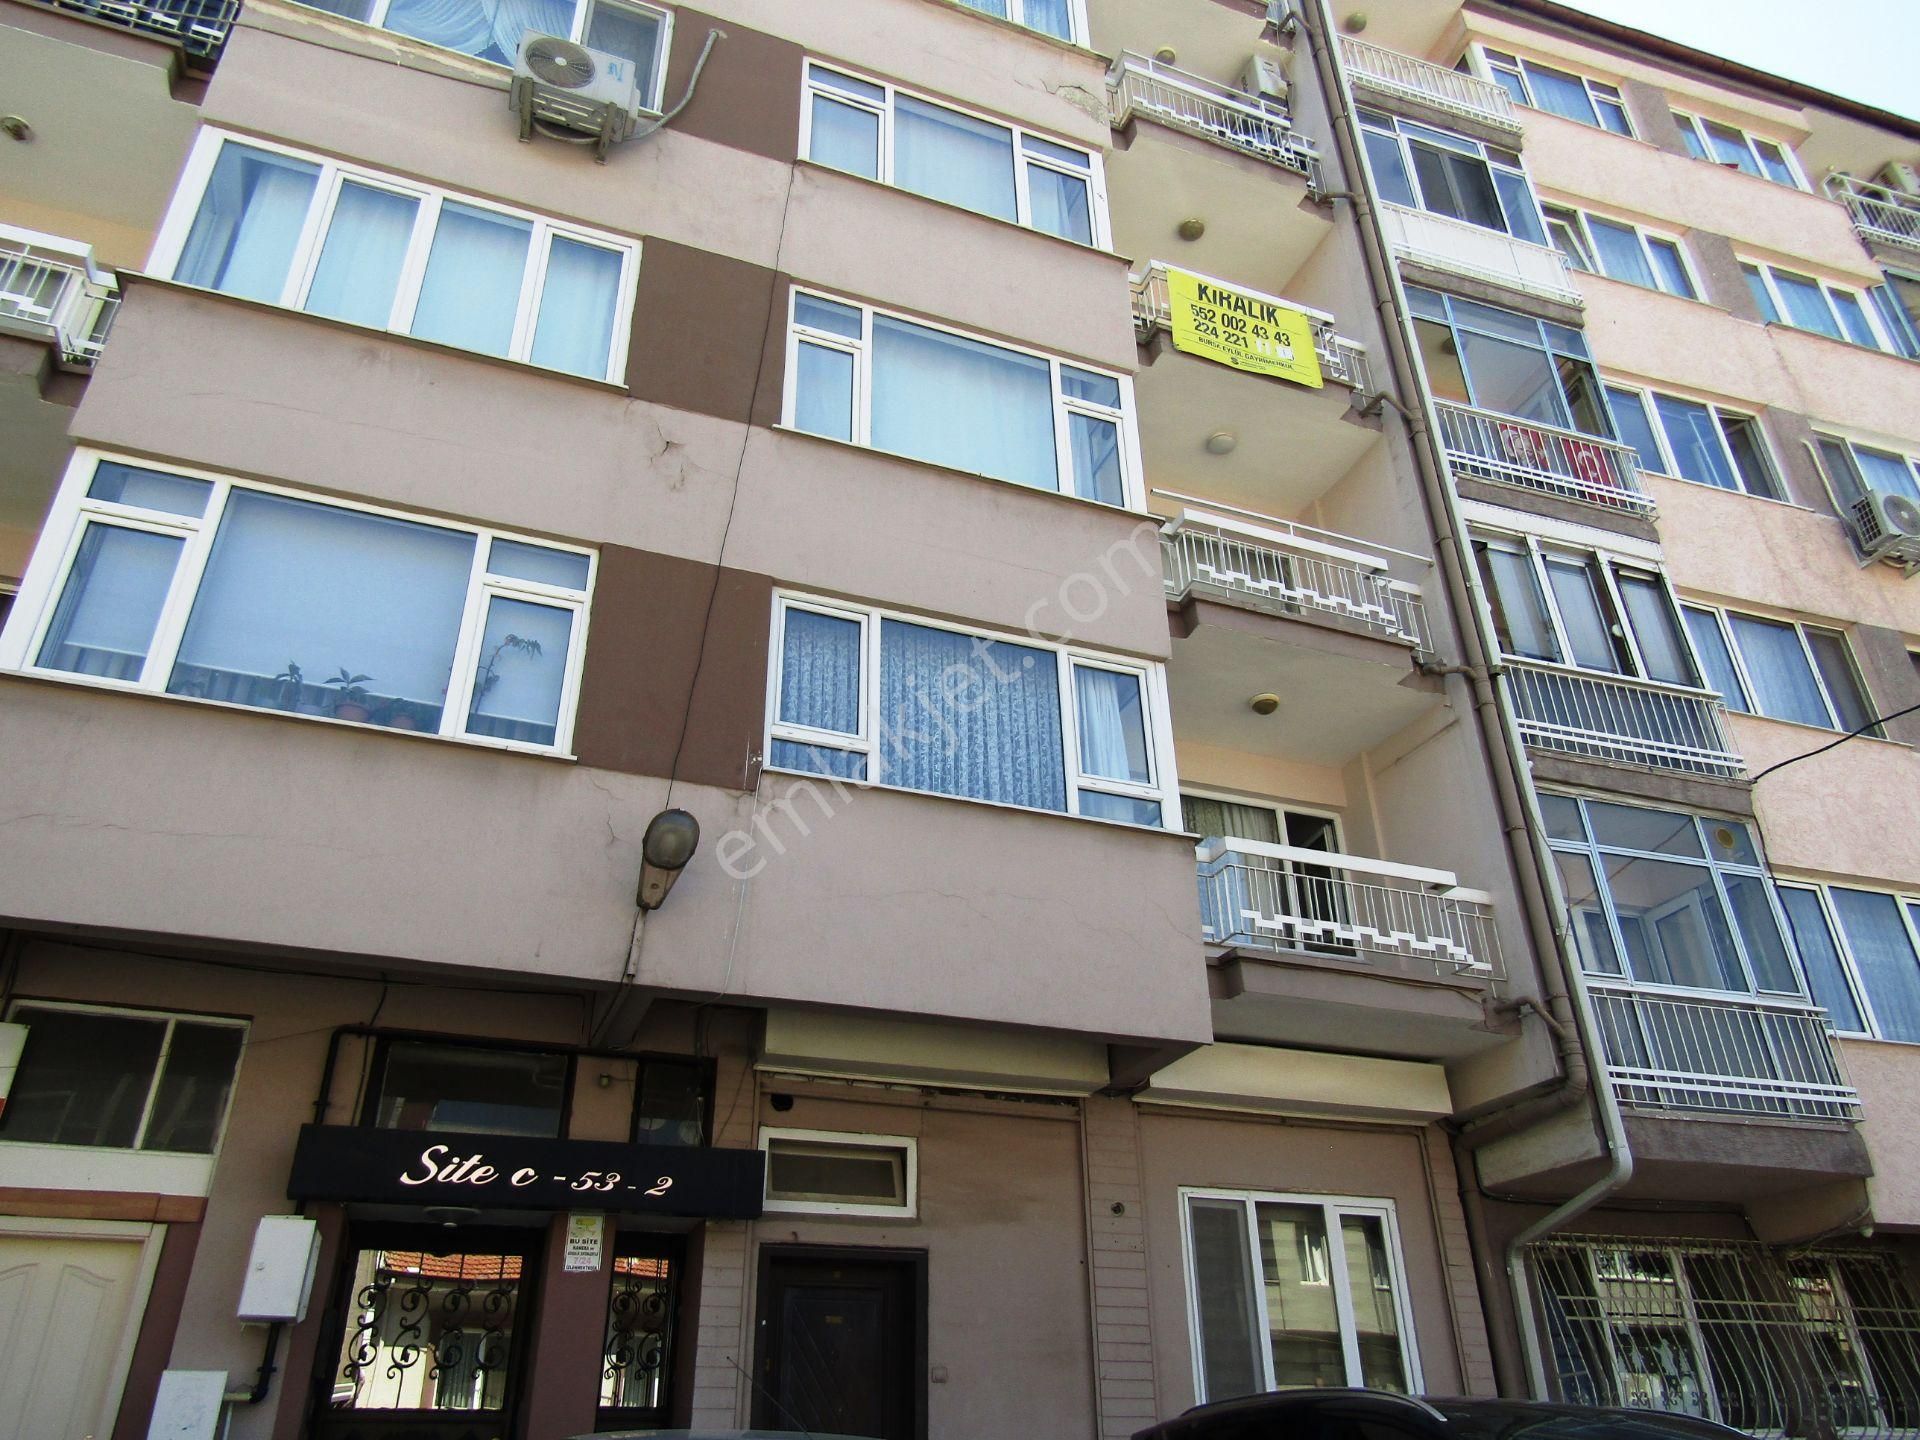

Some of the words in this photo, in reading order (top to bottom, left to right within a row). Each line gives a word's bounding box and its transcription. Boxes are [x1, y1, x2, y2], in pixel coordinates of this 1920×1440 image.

[1191, 304, 1216, 323] 552
[1221, 313, 1247, 333] 002
[1252, 324, 1269, 340] 43
[1274, 331, 1291, 347] 43
[1198, 283, 1279, 327] KIRALIK
[1193, 318, 1219, 339] 224
[1222, 330, 1248, 348] 221
[400, 1144, 499, 1186] Site
